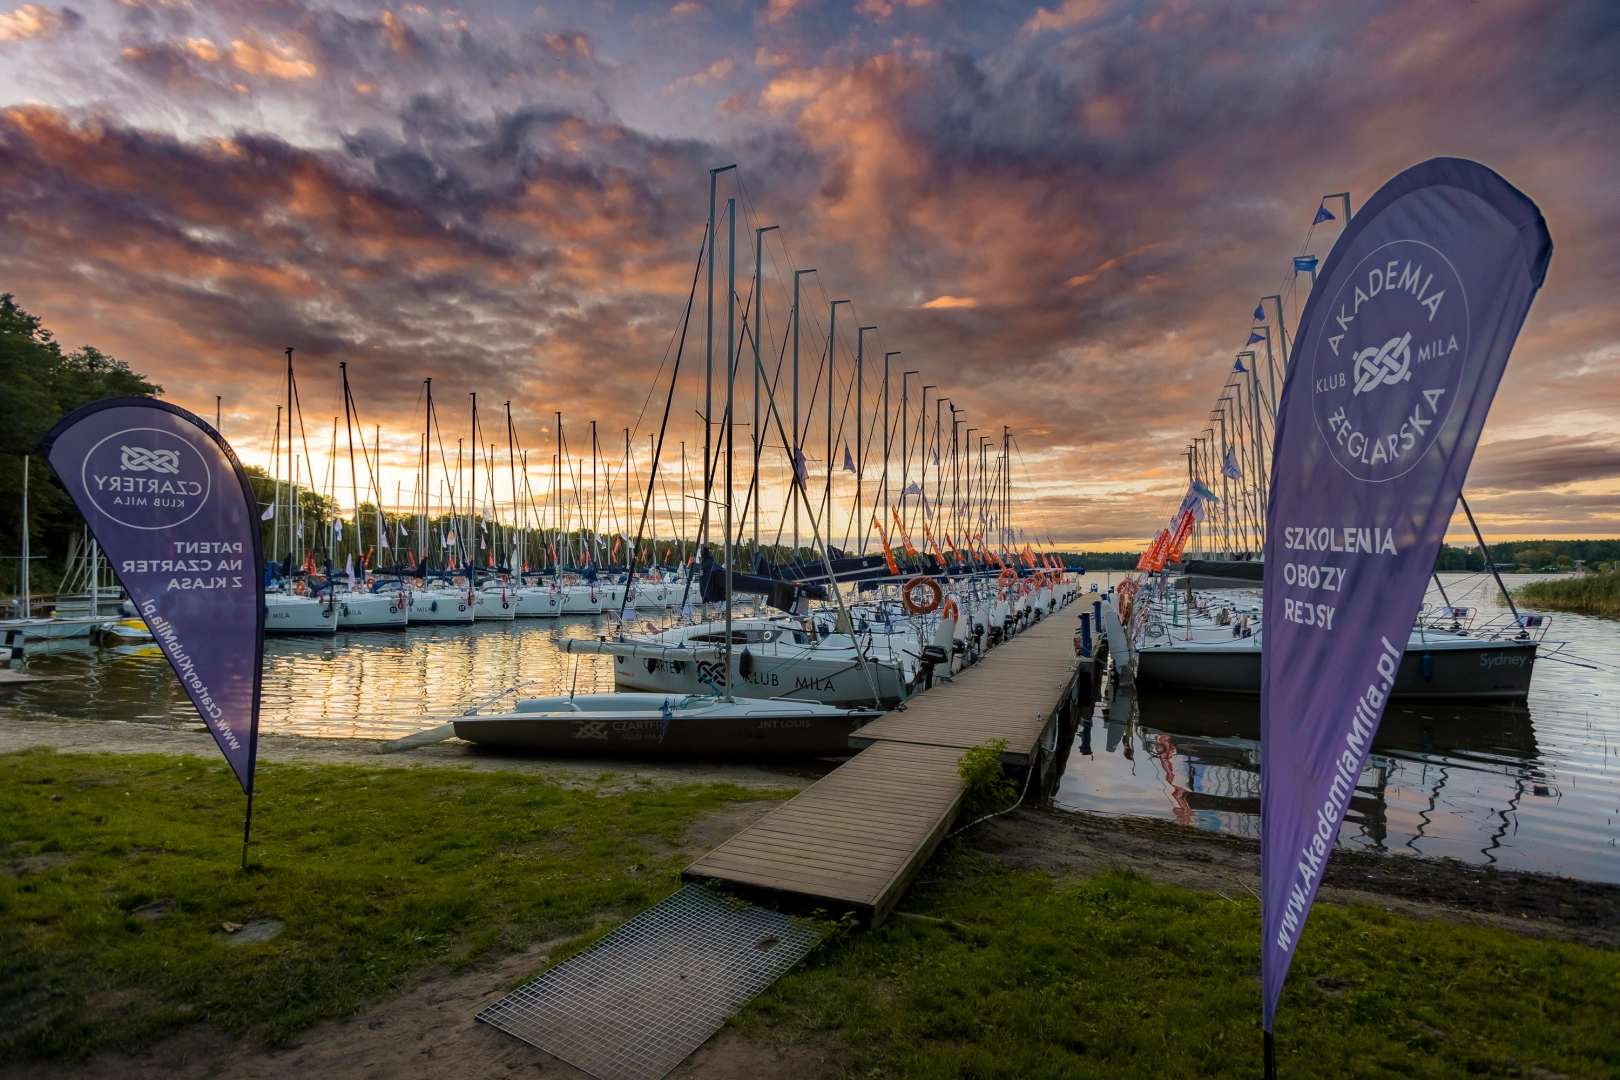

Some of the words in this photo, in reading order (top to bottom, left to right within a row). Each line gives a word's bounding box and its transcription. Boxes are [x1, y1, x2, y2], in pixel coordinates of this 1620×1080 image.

[1328, 260, 1445, 356] AKADEMIA
[1316, 372, 1346, 394] KLUB
[1417, 335, 1459, 363] MILA
[1284, 526, 1398, 555] SZKOLENIA
[1283, 563, 1347, 592] OBOZY
[1284, 598, 1336, 630] REJSY
[1479, 652, 1527, 669] Sydney
[795, 675, 835, 692] MILA
[780, 720, 811, 728] LOUIS
[1276, 636, 1400, 952] www.AkademiaMila.pl
